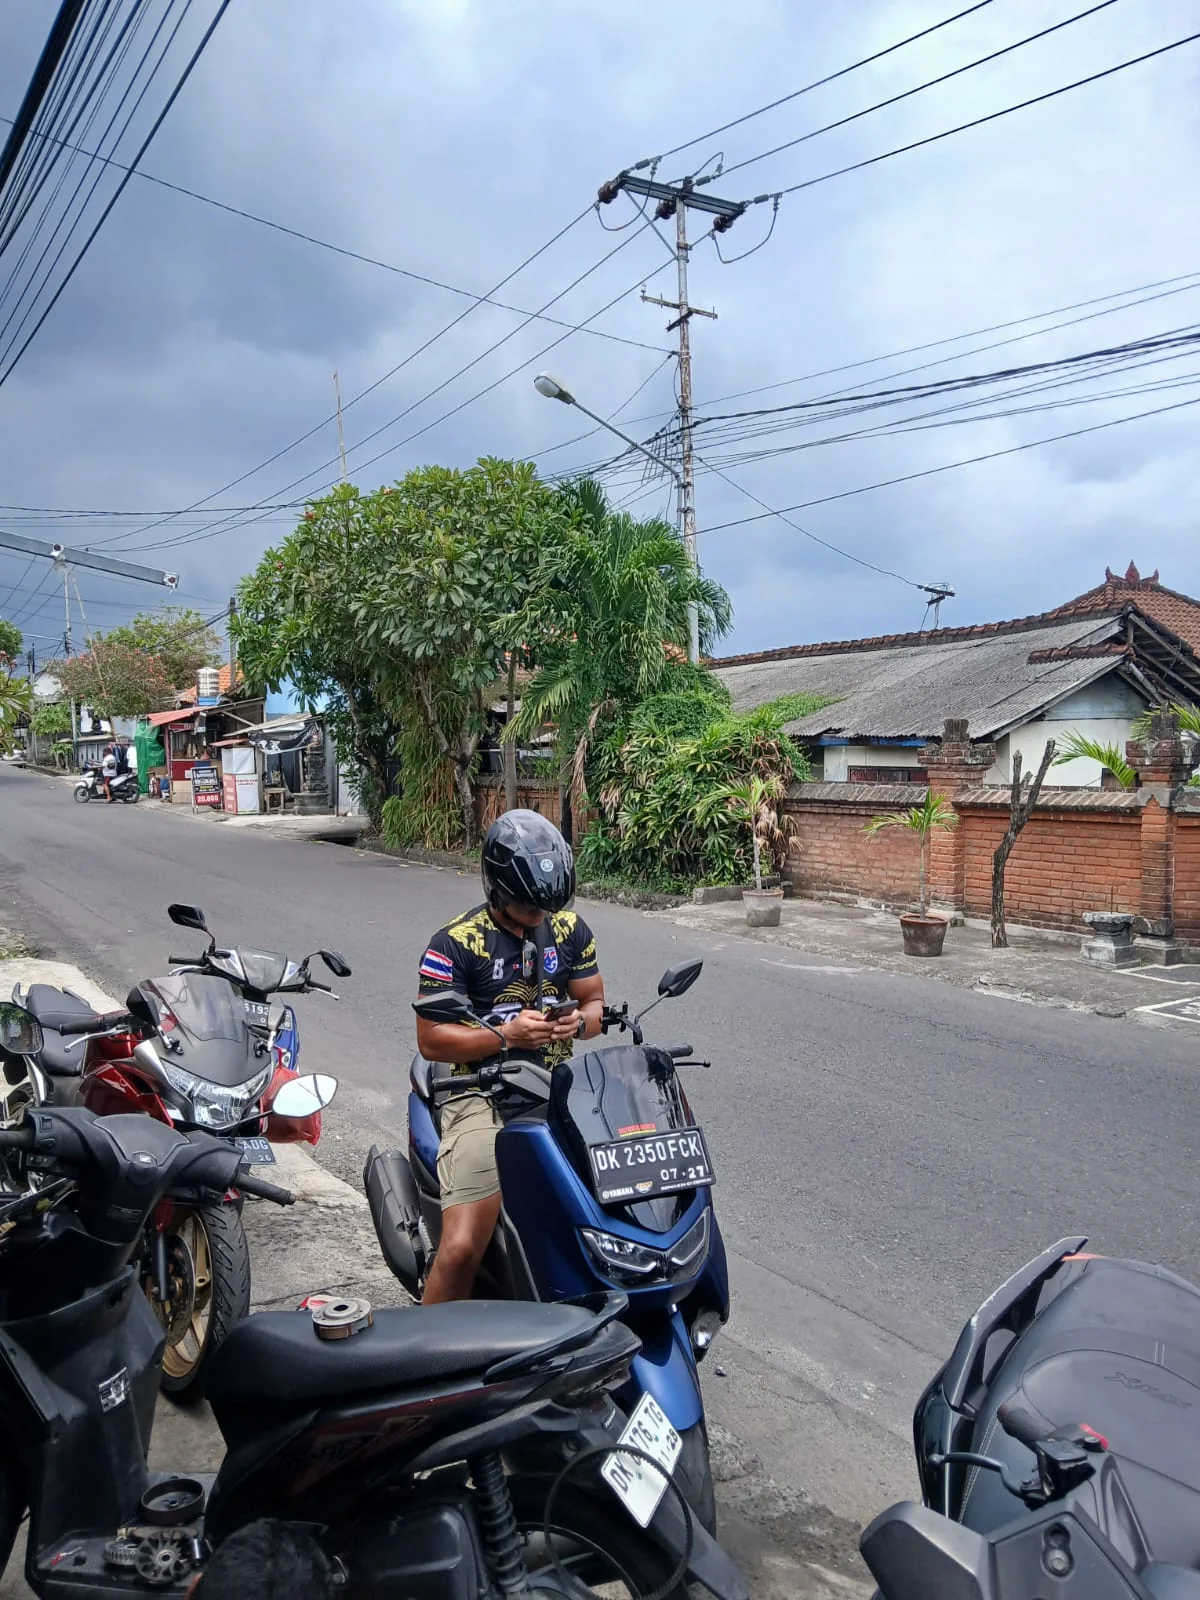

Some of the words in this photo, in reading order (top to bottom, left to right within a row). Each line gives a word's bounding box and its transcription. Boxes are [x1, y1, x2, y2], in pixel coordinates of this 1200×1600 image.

[596, 1148, 620, 1171] DK
[609, 1186, 634, 1198] YAMAHA
[610, 1455, 634, 1494] DK
[643, 1401, 664, 1429] TG
